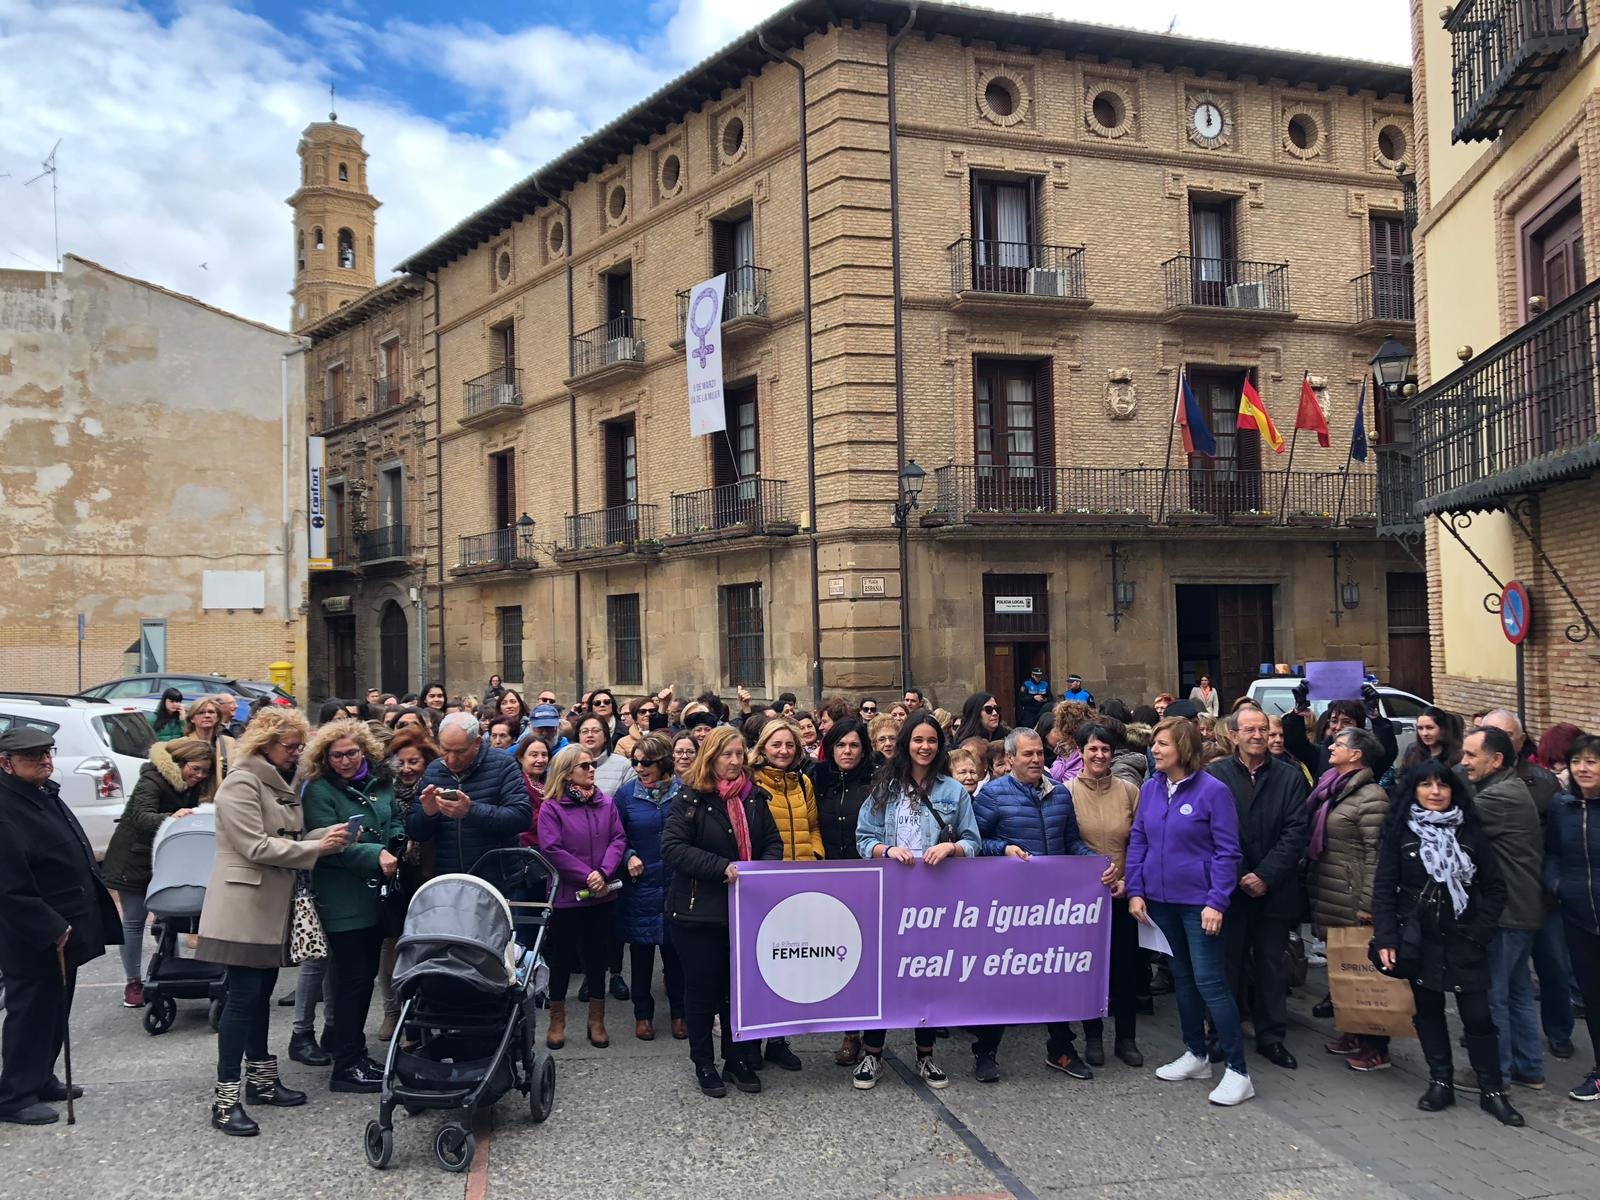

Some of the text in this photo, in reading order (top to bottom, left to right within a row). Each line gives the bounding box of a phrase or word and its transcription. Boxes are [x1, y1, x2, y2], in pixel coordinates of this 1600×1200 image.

[897, 896, 1103, 935] por la igualdad
[772, 945, 847, 962] FEMENINO
[897, 946, 1093, 983] real y efectiva
[1340, 962, 1376, 973] SPRING
